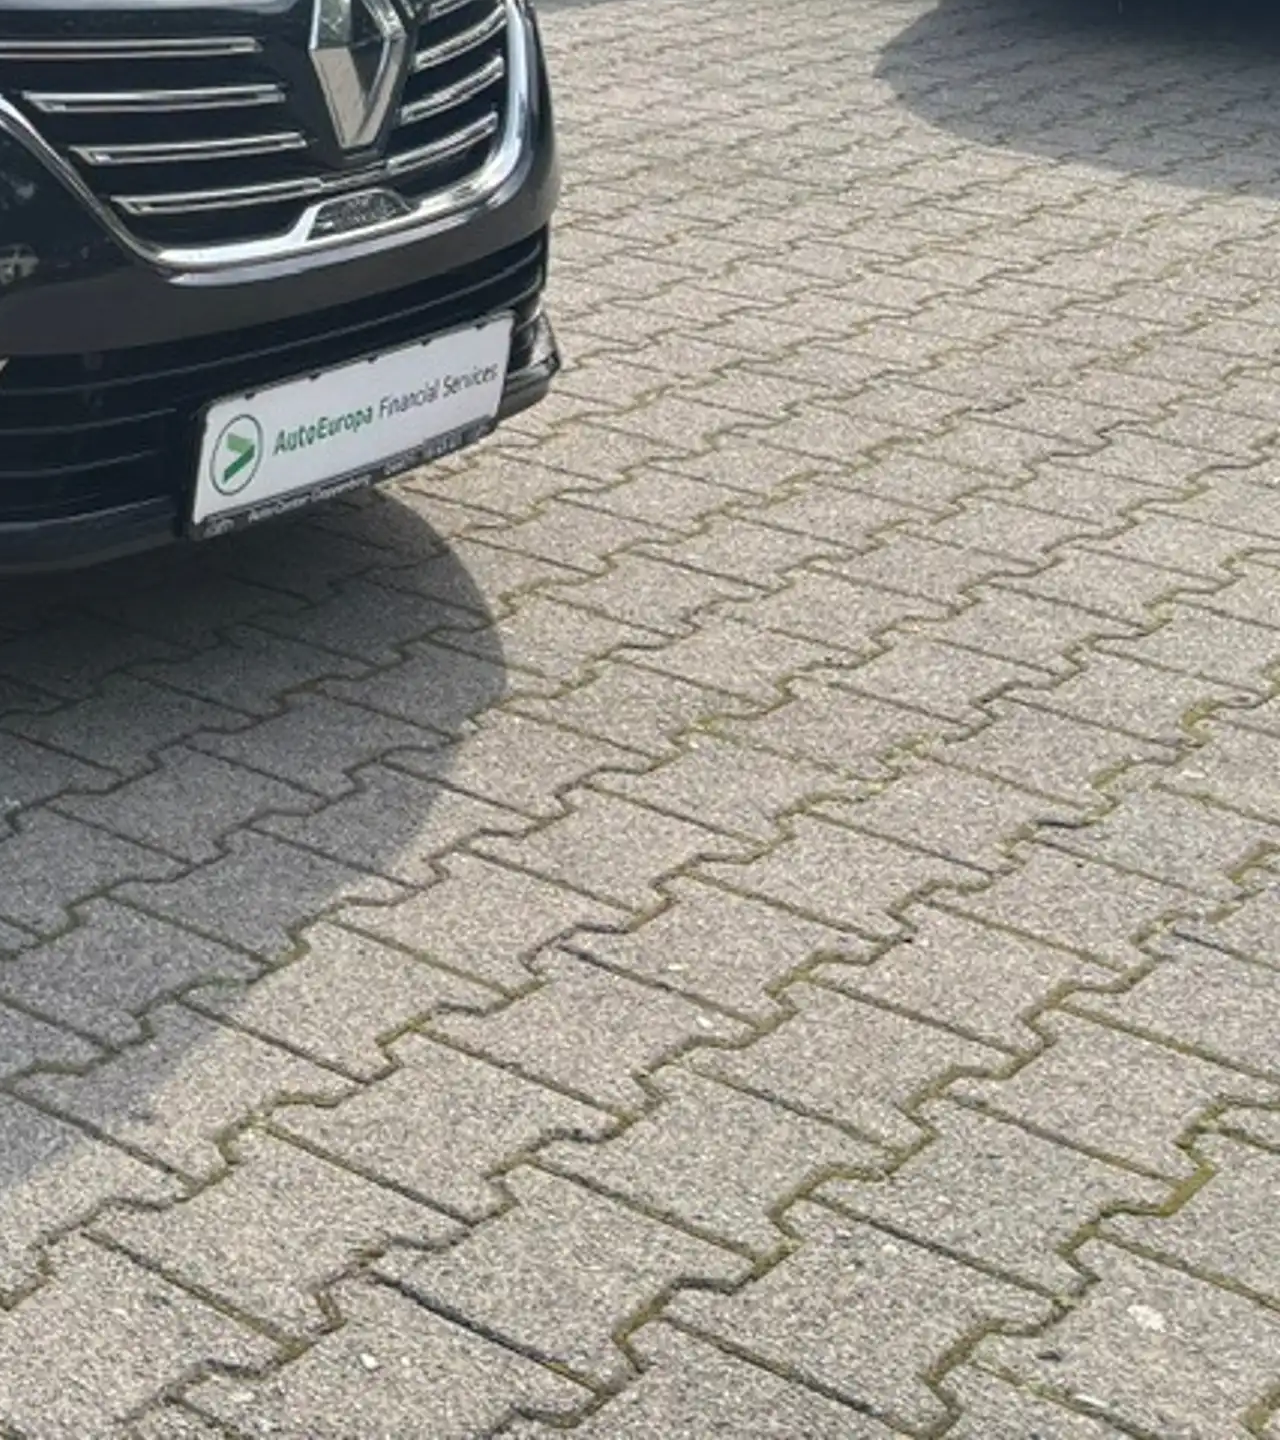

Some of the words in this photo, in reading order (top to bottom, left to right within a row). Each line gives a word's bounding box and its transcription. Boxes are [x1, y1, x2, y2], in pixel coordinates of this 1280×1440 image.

[272, 404, 373, 456] AutoEuropa
[378, 377, 440, 419] Financial
[442, 362, 500, 399] Services
